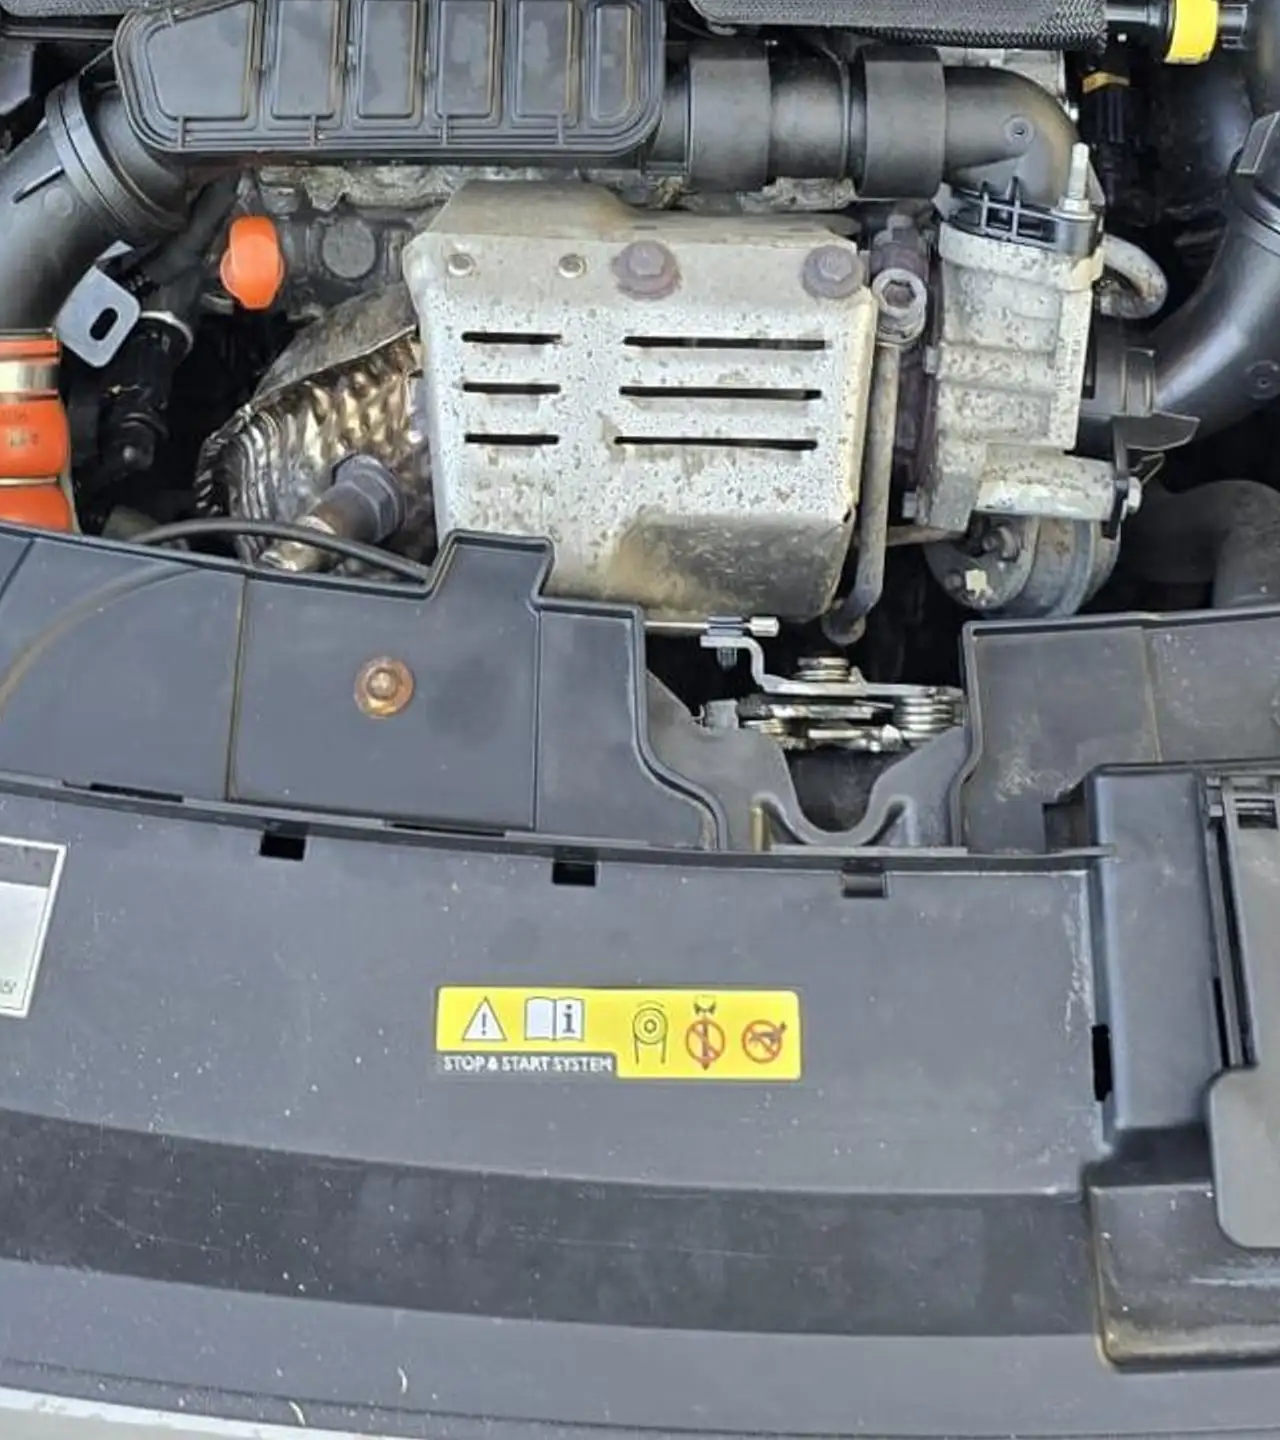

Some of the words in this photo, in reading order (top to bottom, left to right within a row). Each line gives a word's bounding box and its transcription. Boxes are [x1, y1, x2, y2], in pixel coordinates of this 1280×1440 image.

[443, 1055, 486, 1072] STOP
[486, 1057, 500, 1071] &
[501, 1055, 550, 1072] START
[552, 1055, 613, 1072] SYSTEM
